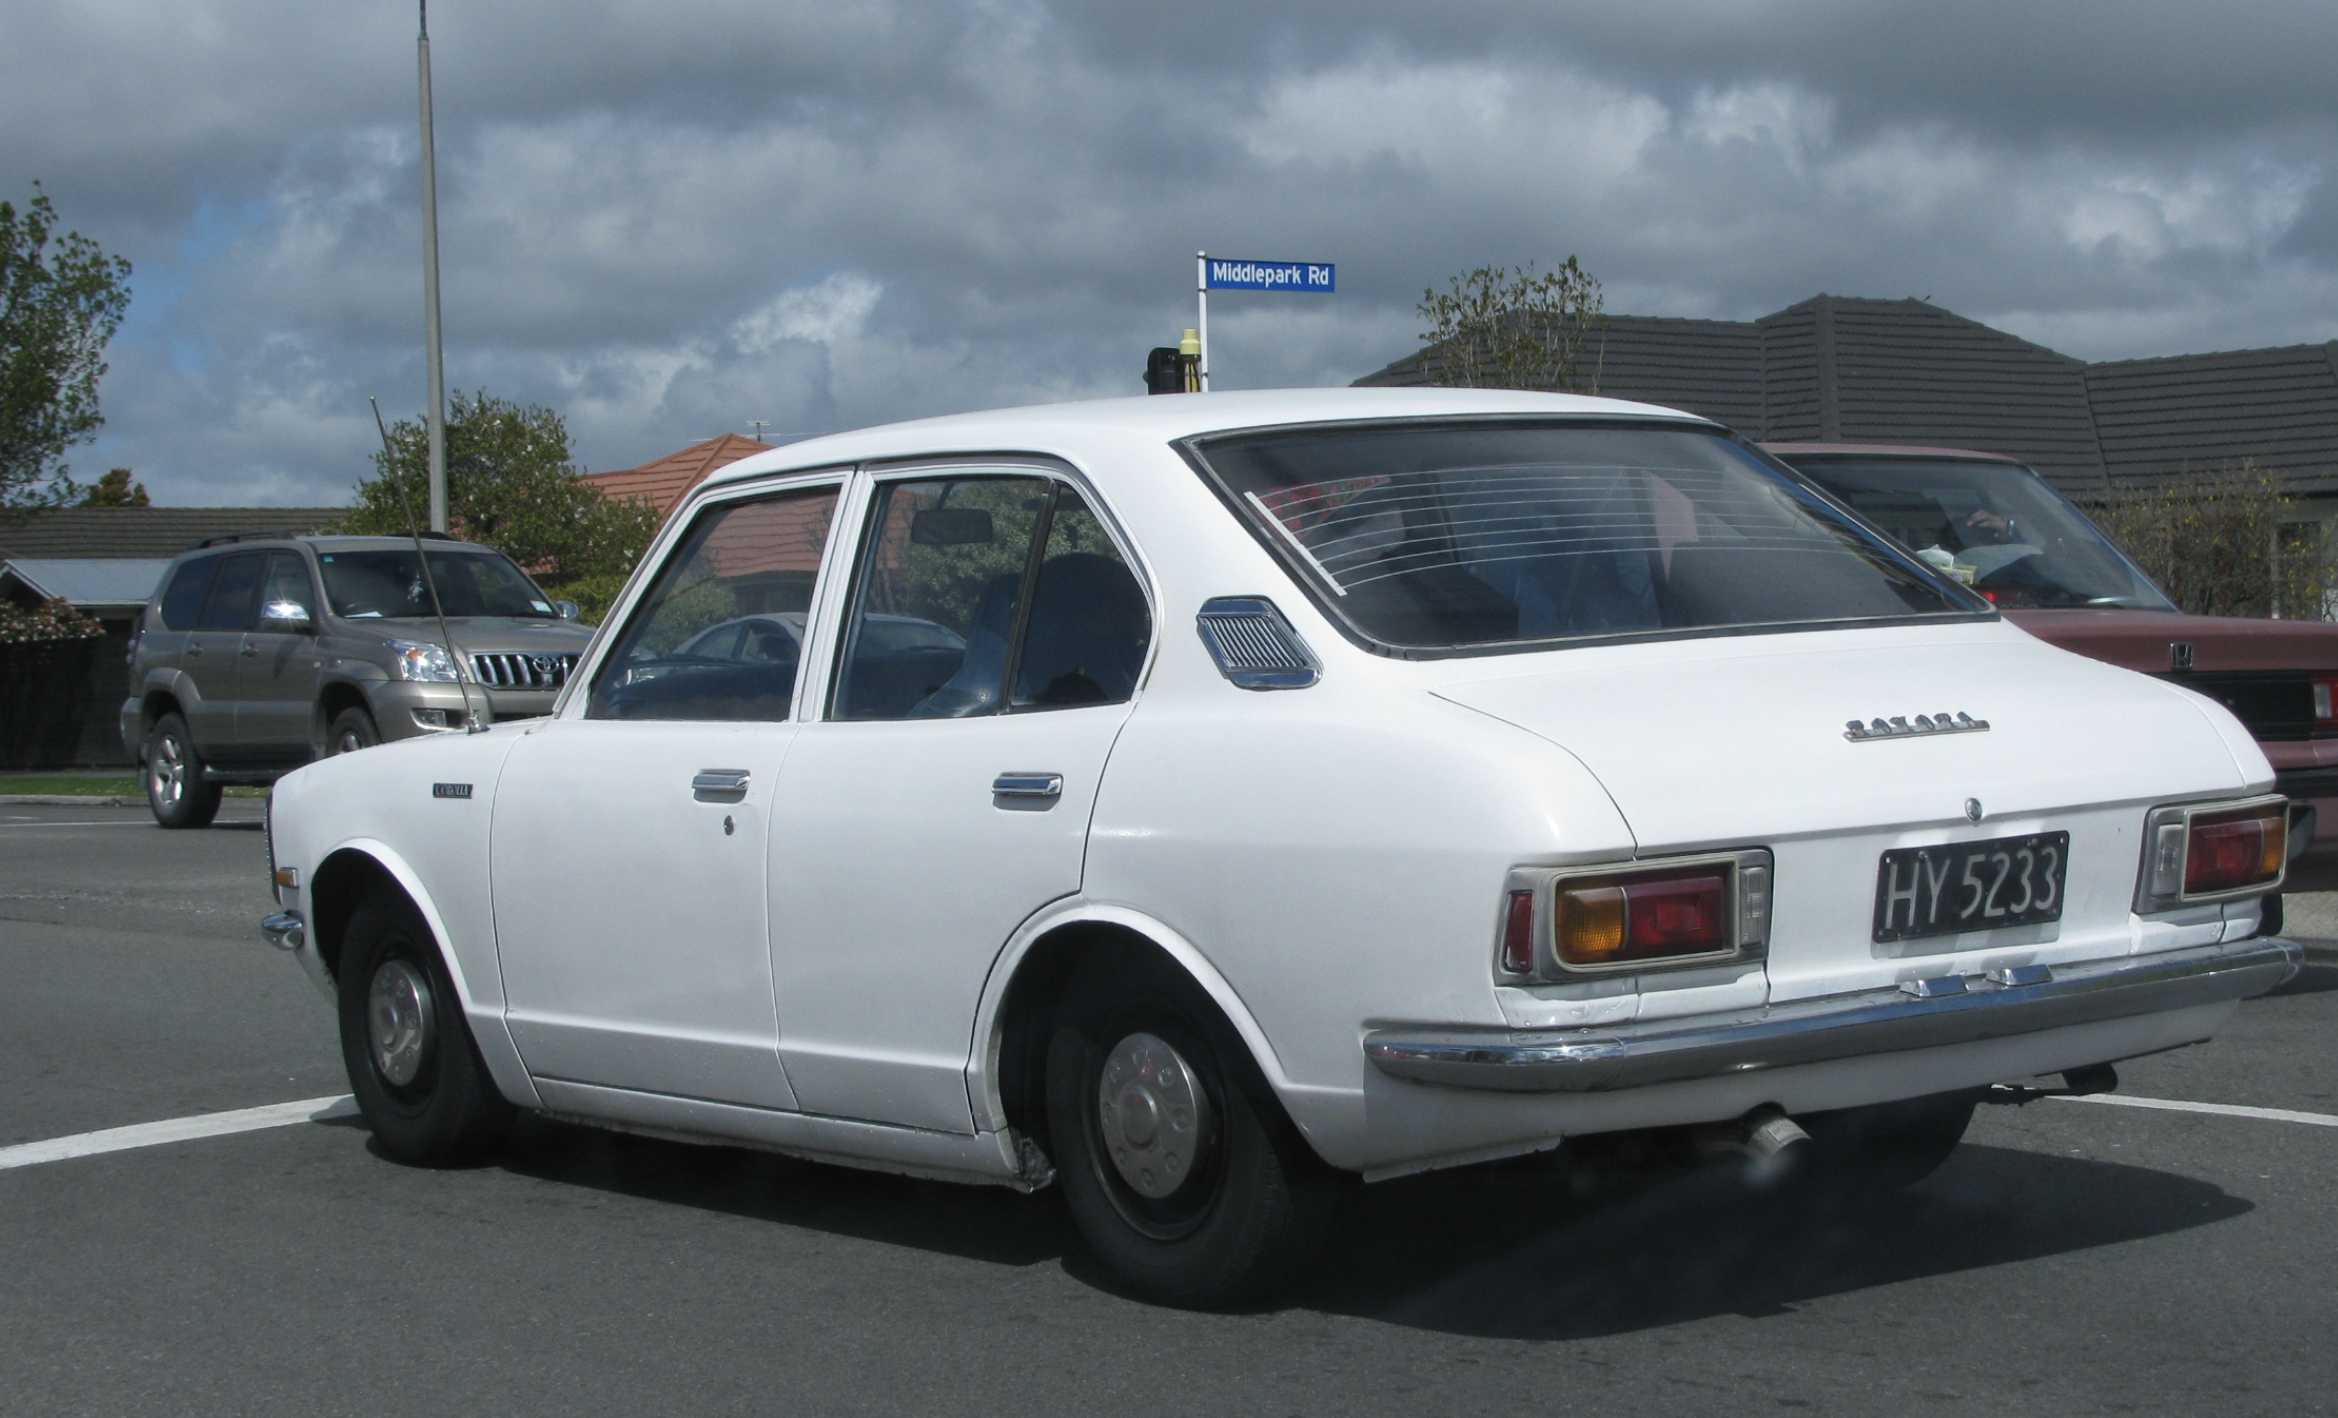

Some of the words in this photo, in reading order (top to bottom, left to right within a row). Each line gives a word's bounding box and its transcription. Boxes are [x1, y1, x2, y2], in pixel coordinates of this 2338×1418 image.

[1213, 262, 1302, 288] Middlepark
[1308, 265, 1329, 286] Rd
[1885, 859, 1950, 930] HY
[1960, 846, 2058, 919] 5233
